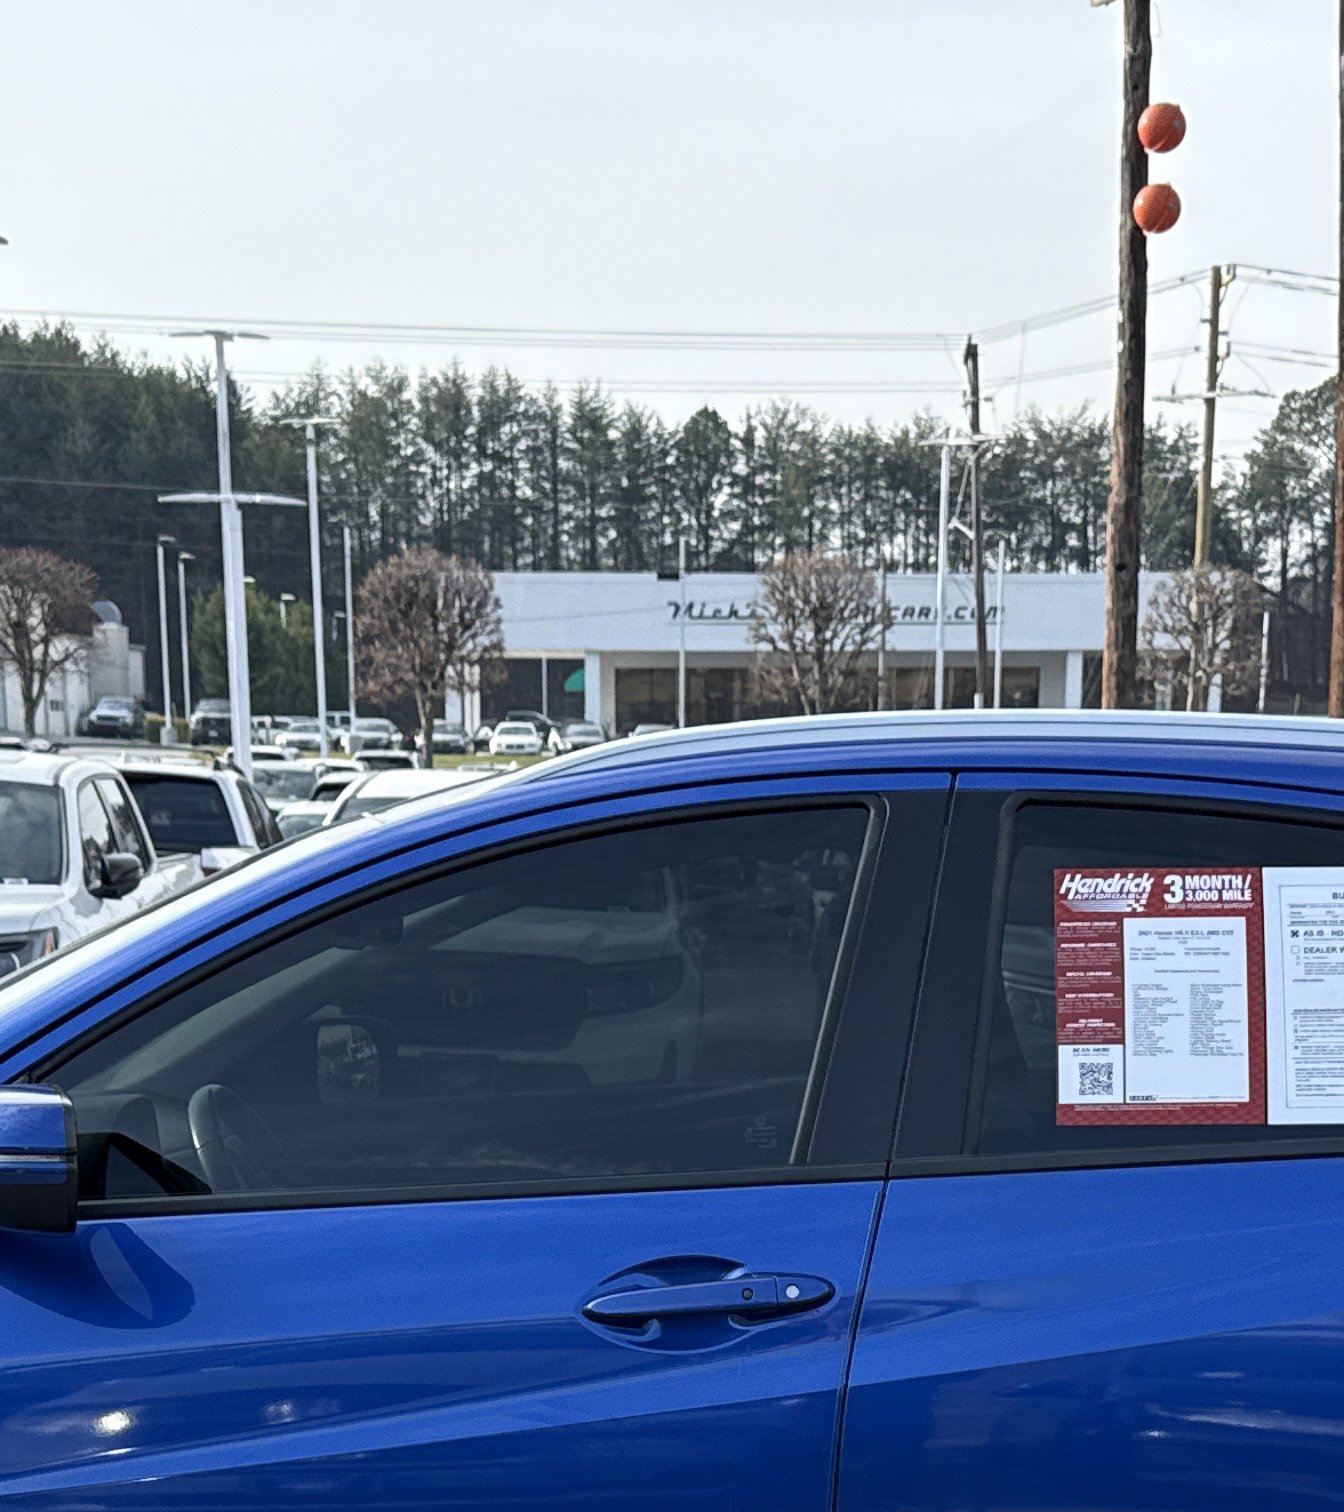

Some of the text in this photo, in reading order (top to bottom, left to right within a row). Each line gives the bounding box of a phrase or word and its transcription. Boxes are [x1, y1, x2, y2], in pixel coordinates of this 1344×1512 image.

[1059, 872, 1155, 900] Hendrick
[1163, 873, 1253, 904] 3 MONTH/
[1221, 889, 1253, 901] MILE
[1303, 946, 1338, 954] DEALER
